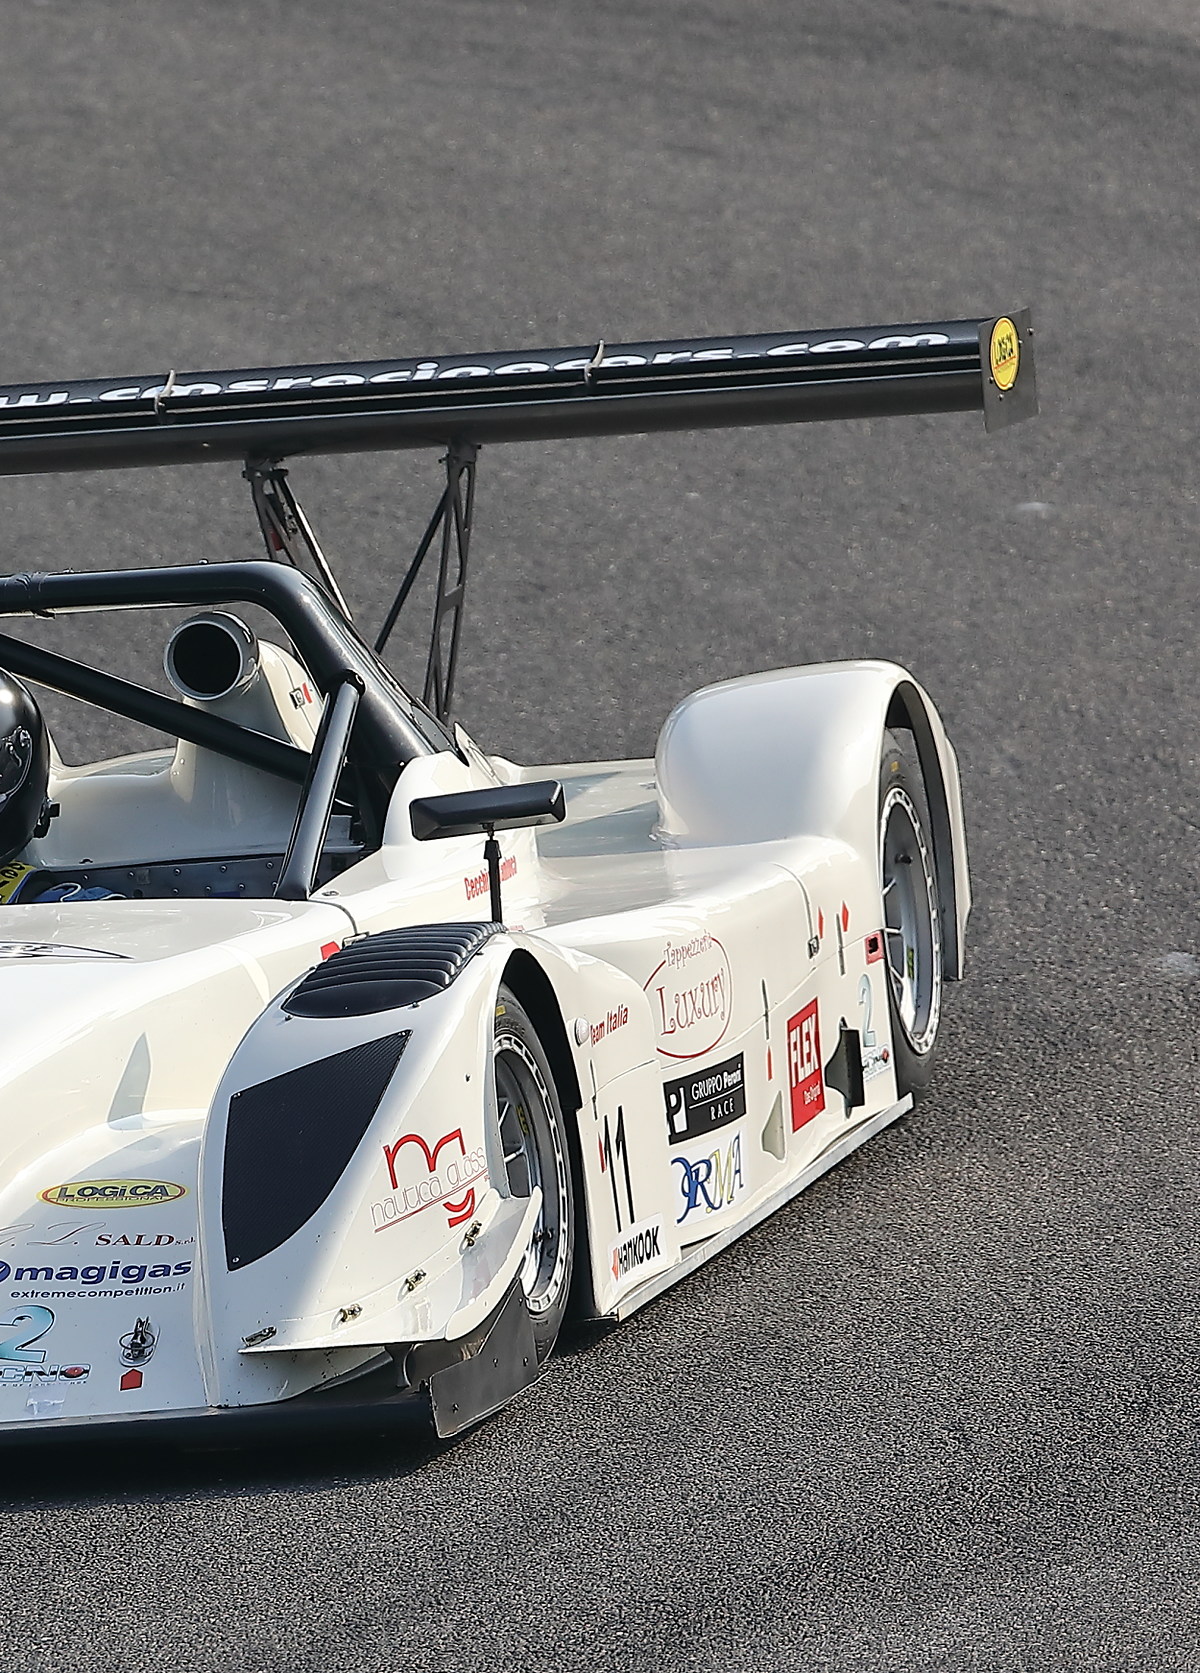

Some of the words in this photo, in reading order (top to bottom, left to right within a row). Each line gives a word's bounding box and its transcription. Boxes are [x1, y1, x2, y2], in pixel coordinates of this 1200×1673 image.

[606, 1003, 629, 1035] Italia
[858, 973, 876, 1047] 2
[789, 1012, 819, 1088] FLEX
[691, 1074, 723, 1100] GRUPPO
[723, 1063, 741, 1089] Peroni
[710, 1097, 734, 1121] RACE
[603, 1105, 636, 1234] 11
[370, 1176, 443, 1226] nautica
[10, 1282, 185, 1299] extremecompetition.it
[13, 1259, 193, 1285] magigas
